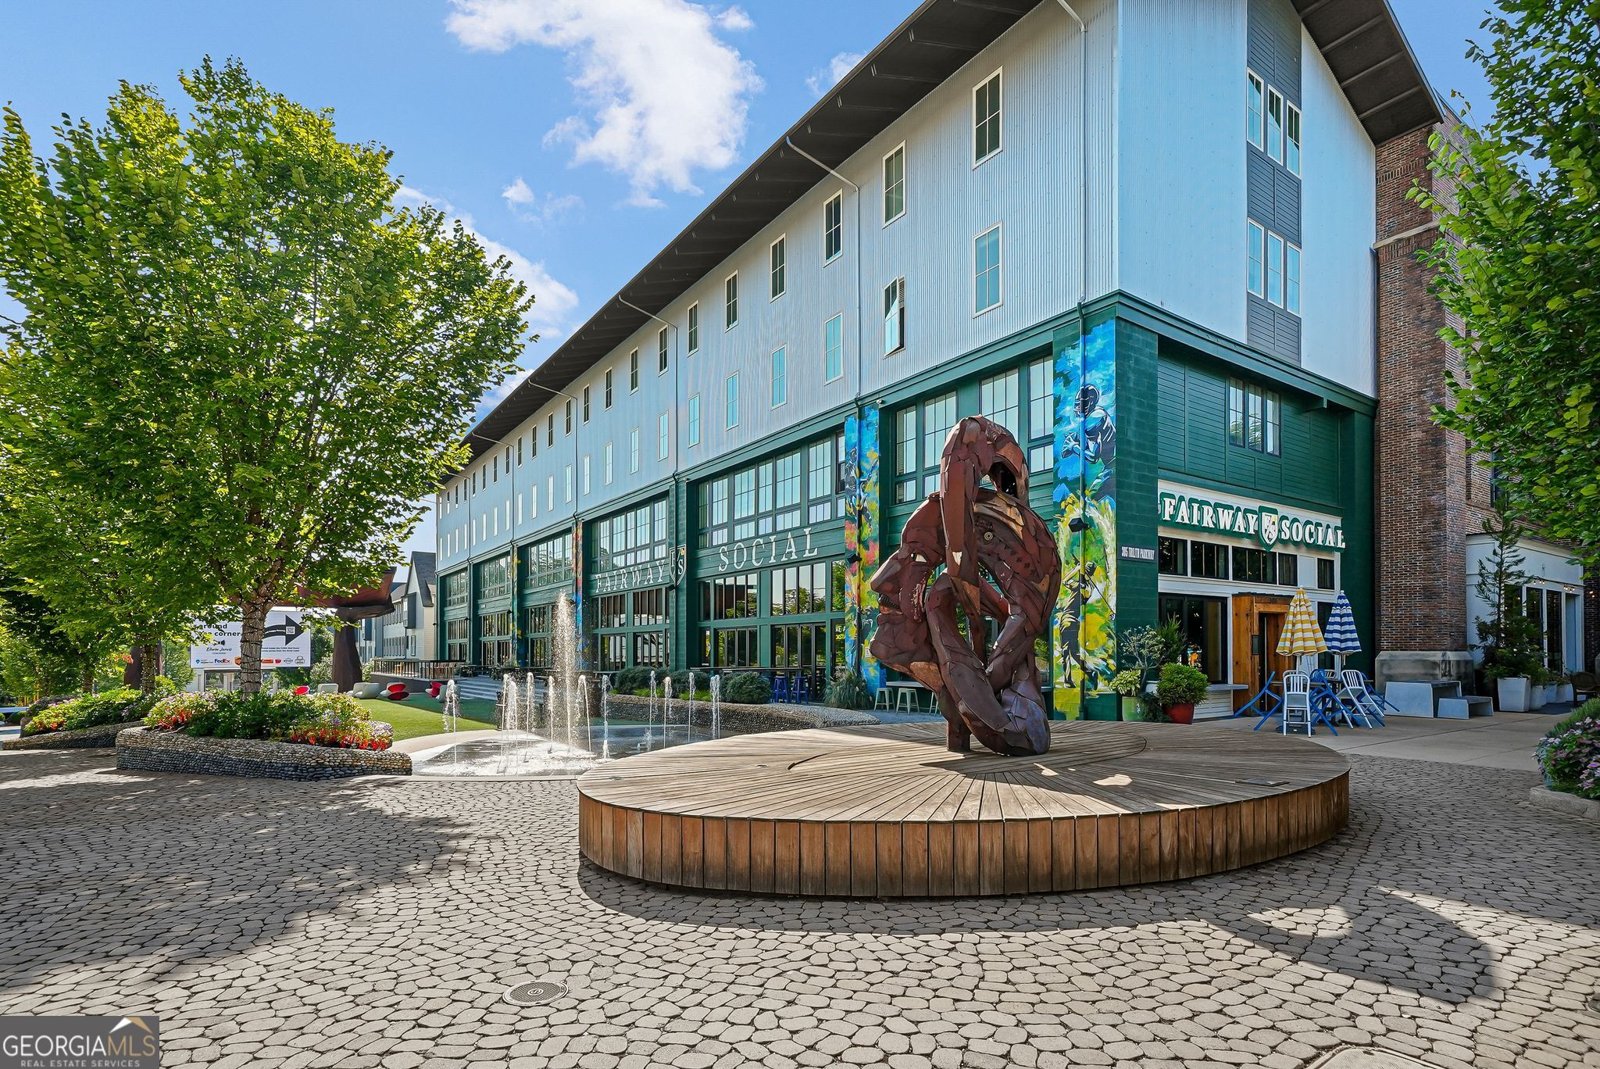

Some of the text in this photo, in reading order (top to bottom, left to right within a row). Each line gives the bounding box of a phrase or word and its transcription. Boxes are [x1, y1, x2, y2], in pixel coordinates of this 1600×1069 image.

[1162, 497, 1258, 535] FAIRWAY
[1281, 519, 1346, 548] SOCIAL
[595, 559, 666, 592] FAIRWAY
[718, 527, 818, 572] SOCIAL
